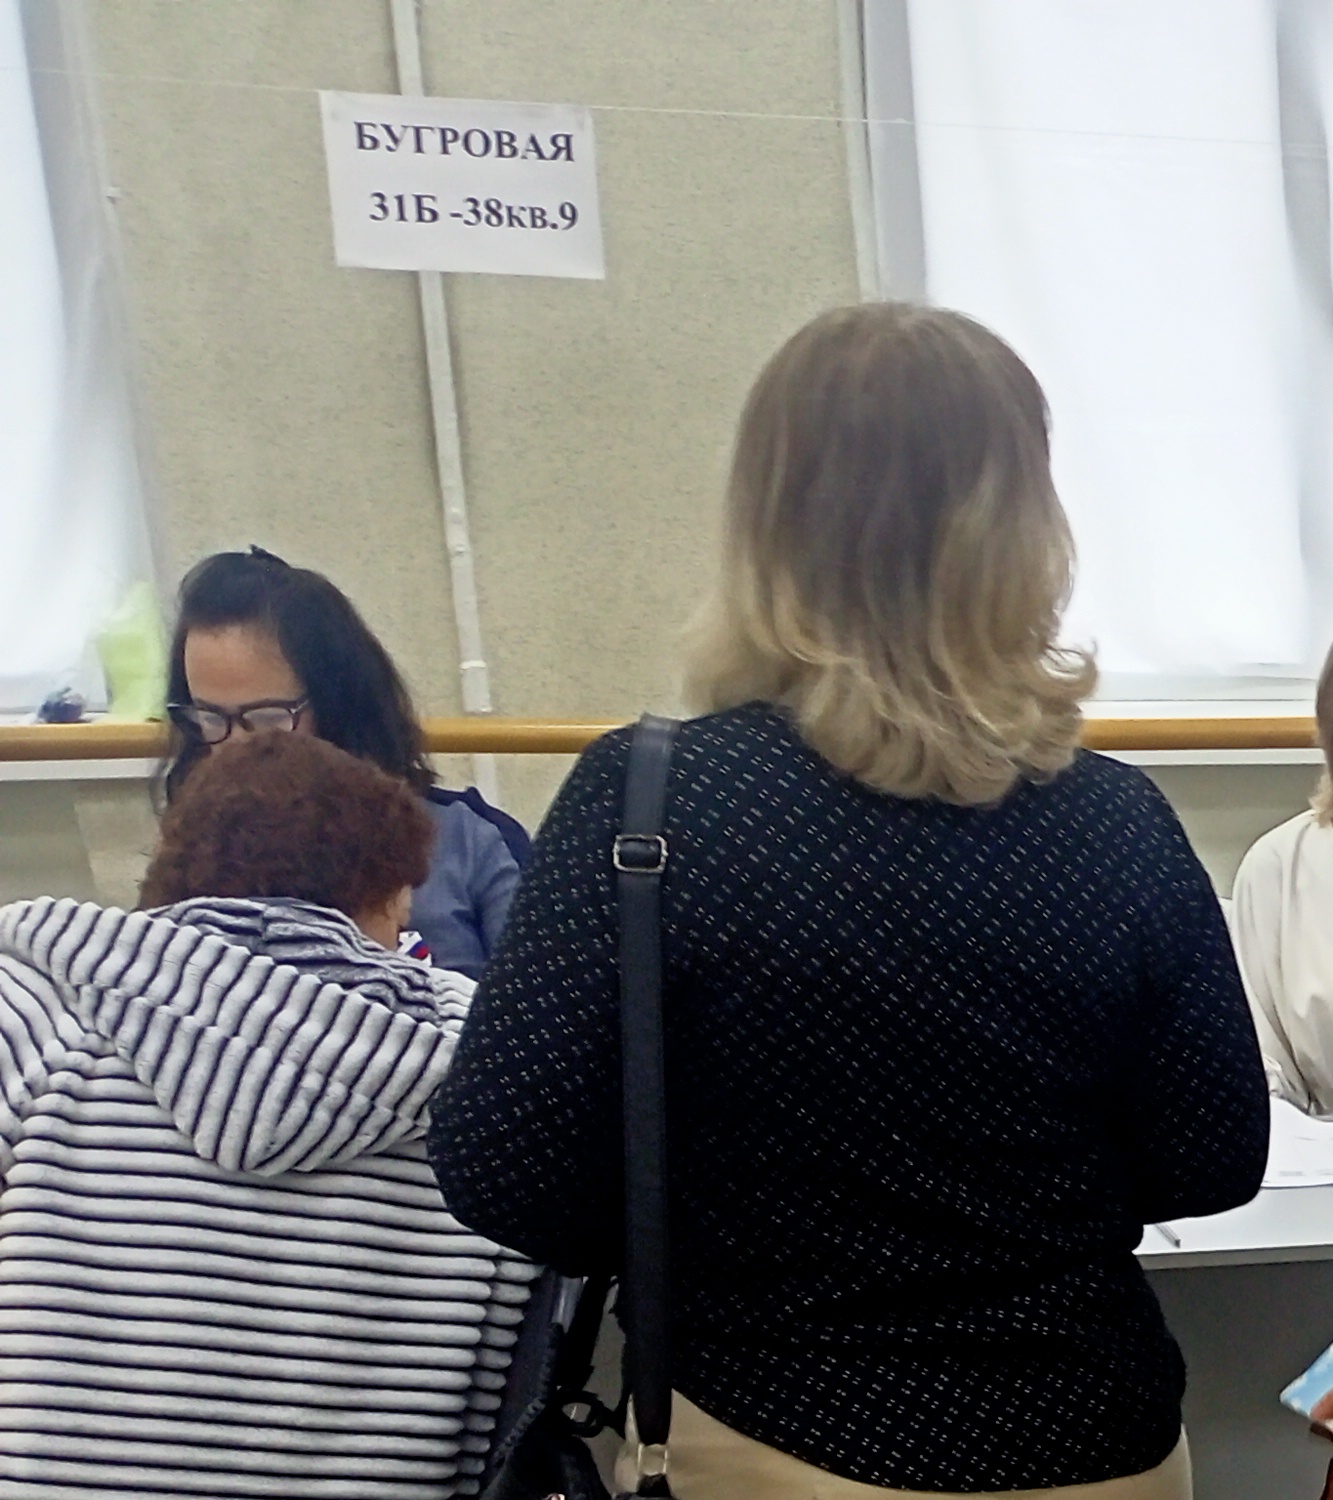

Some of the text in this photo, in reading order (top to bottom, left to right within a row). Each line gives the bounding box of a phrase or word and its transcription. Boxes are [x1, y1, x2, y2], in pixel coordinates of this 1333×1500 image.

[354, 121, 575, 162] БУГРОВАЯ
[369, 192, 578, 230] 31Б -38кв.9
